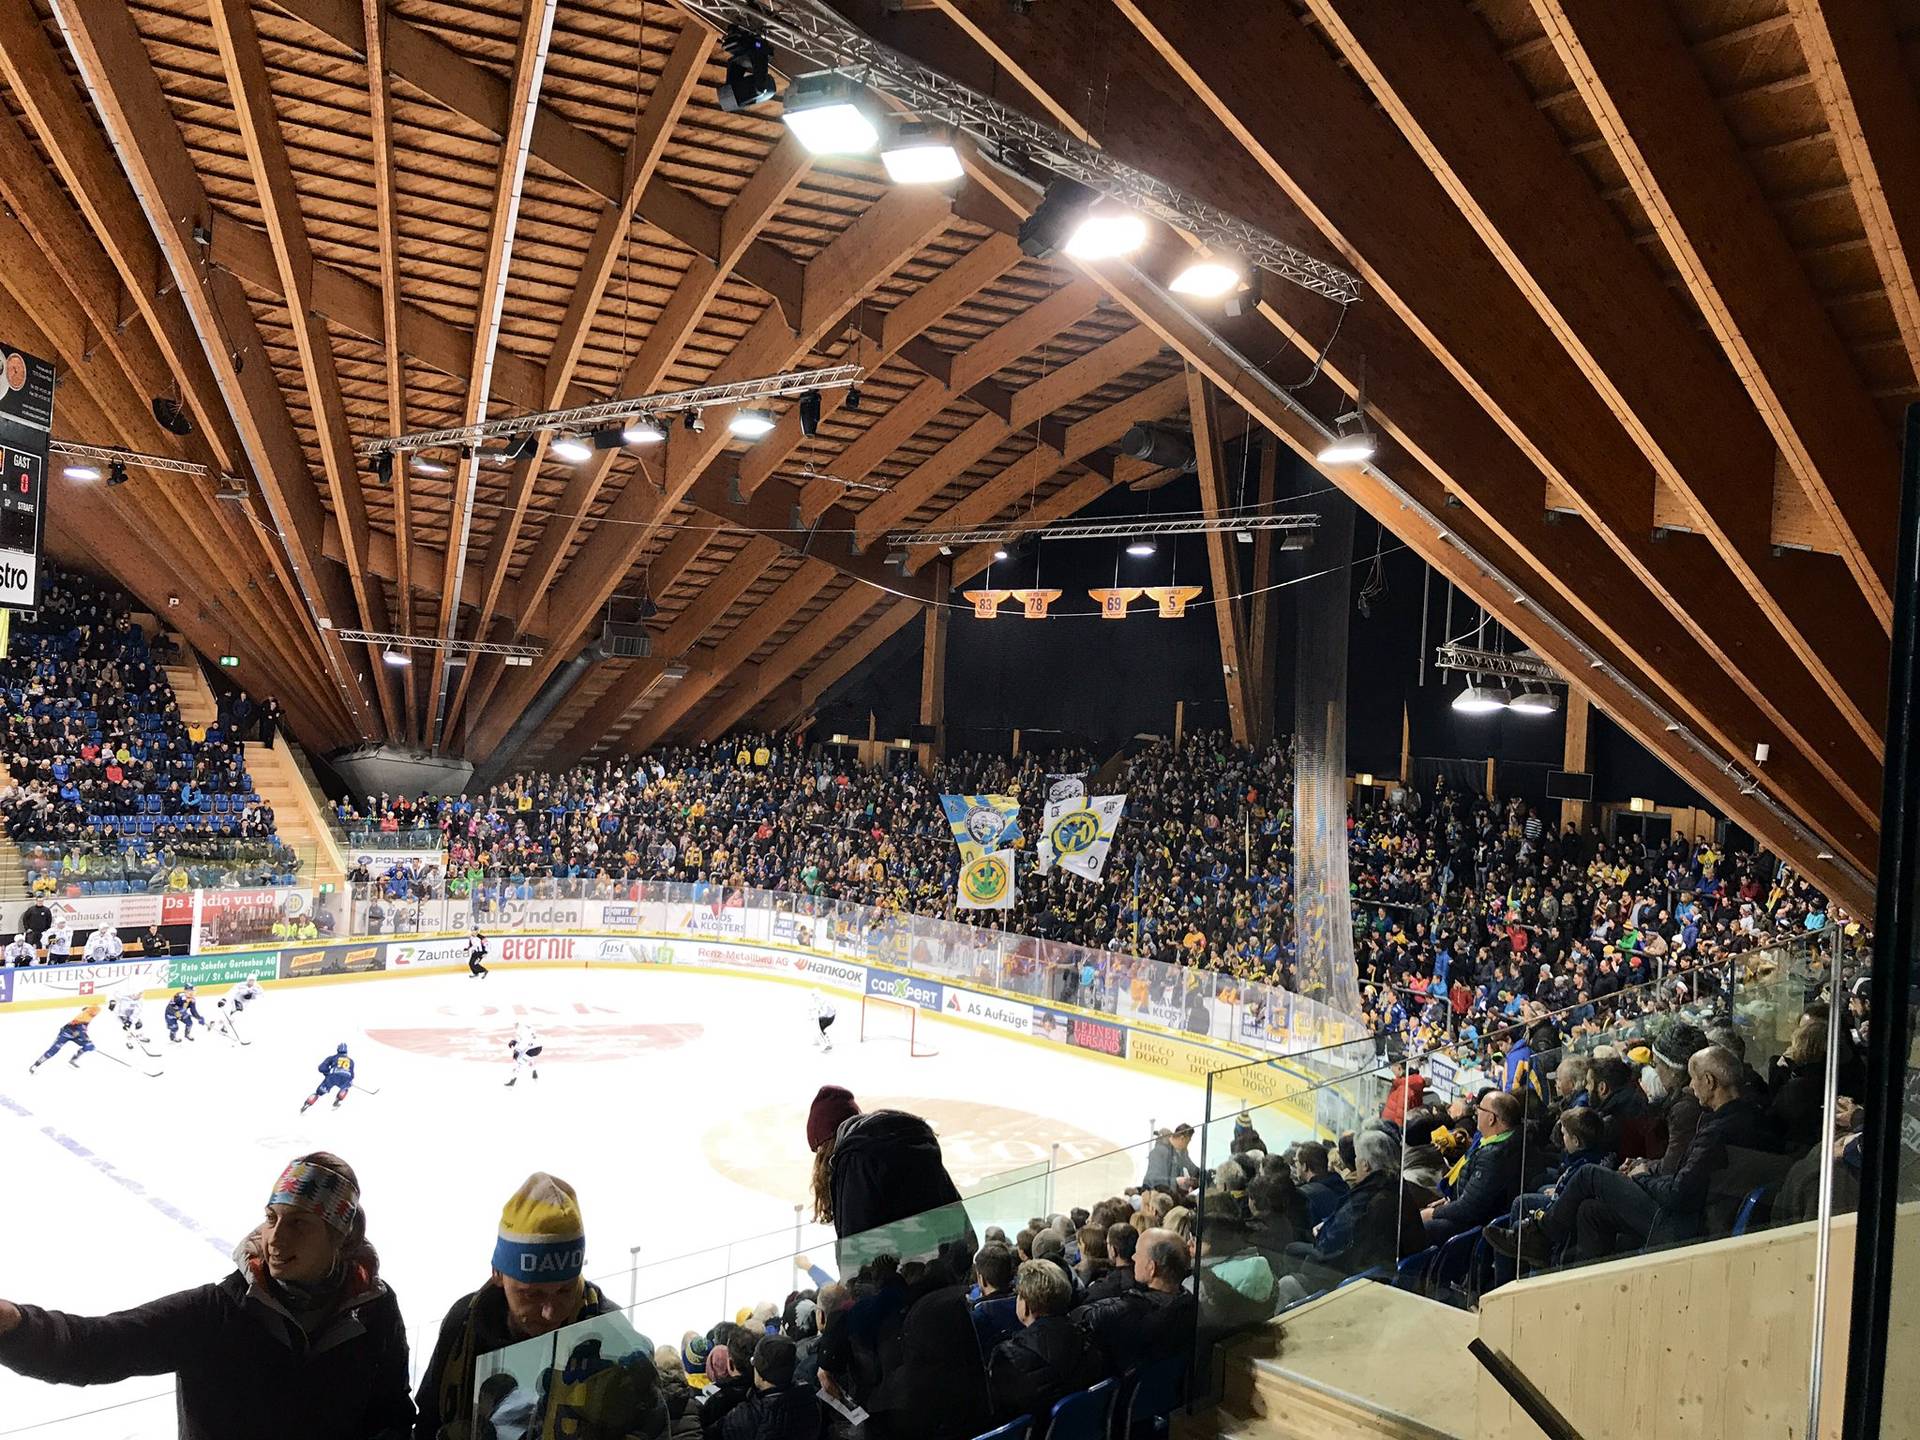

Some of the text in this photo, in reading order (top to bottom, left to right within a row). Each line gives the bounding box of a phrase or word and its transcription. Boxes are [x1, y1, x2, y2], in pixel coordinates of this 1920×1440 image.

[13, 454, 31, 470] GAST
[17, 501, 34, 513] STRAFE
[979, 598, 992, 610] 83
[1030, 597, 1043, 611] 78
[1107, 597, 1121, 610] 69
[1168, 595, 1176, 609] 5
[165, 892, 274, 909] Ds Rdio vu do
[701, 922, 745, 933] KLOSTERS
[417, 948, 470, 962] Zauntea
[502, 938, 576, 960] eternit
[601, 941, 625, 956] Just
[265, 956, 276, 966] AG
[775, 957, 789, 967] AG
[19, 963, 153, 985] MIETERSCHUTZ
[967, 1003, 1029, 1029] AS Aufzüge
[1073, 1020, 1122, 1042] LEHNER
[1073, 1033, 1120, 1054] VERSAND
[1132, 1039, 1175, 1057] CHICCO
[1135, 1050, 1169, 1066] DORO
[1186, 1053, 1228, 1070] CHICCO
[1239, 1066, 1277, 1088] CHICCO
[1242, 1077, 1273, 1097] DORO
[520, 1249, 585, 1273] DAVO
